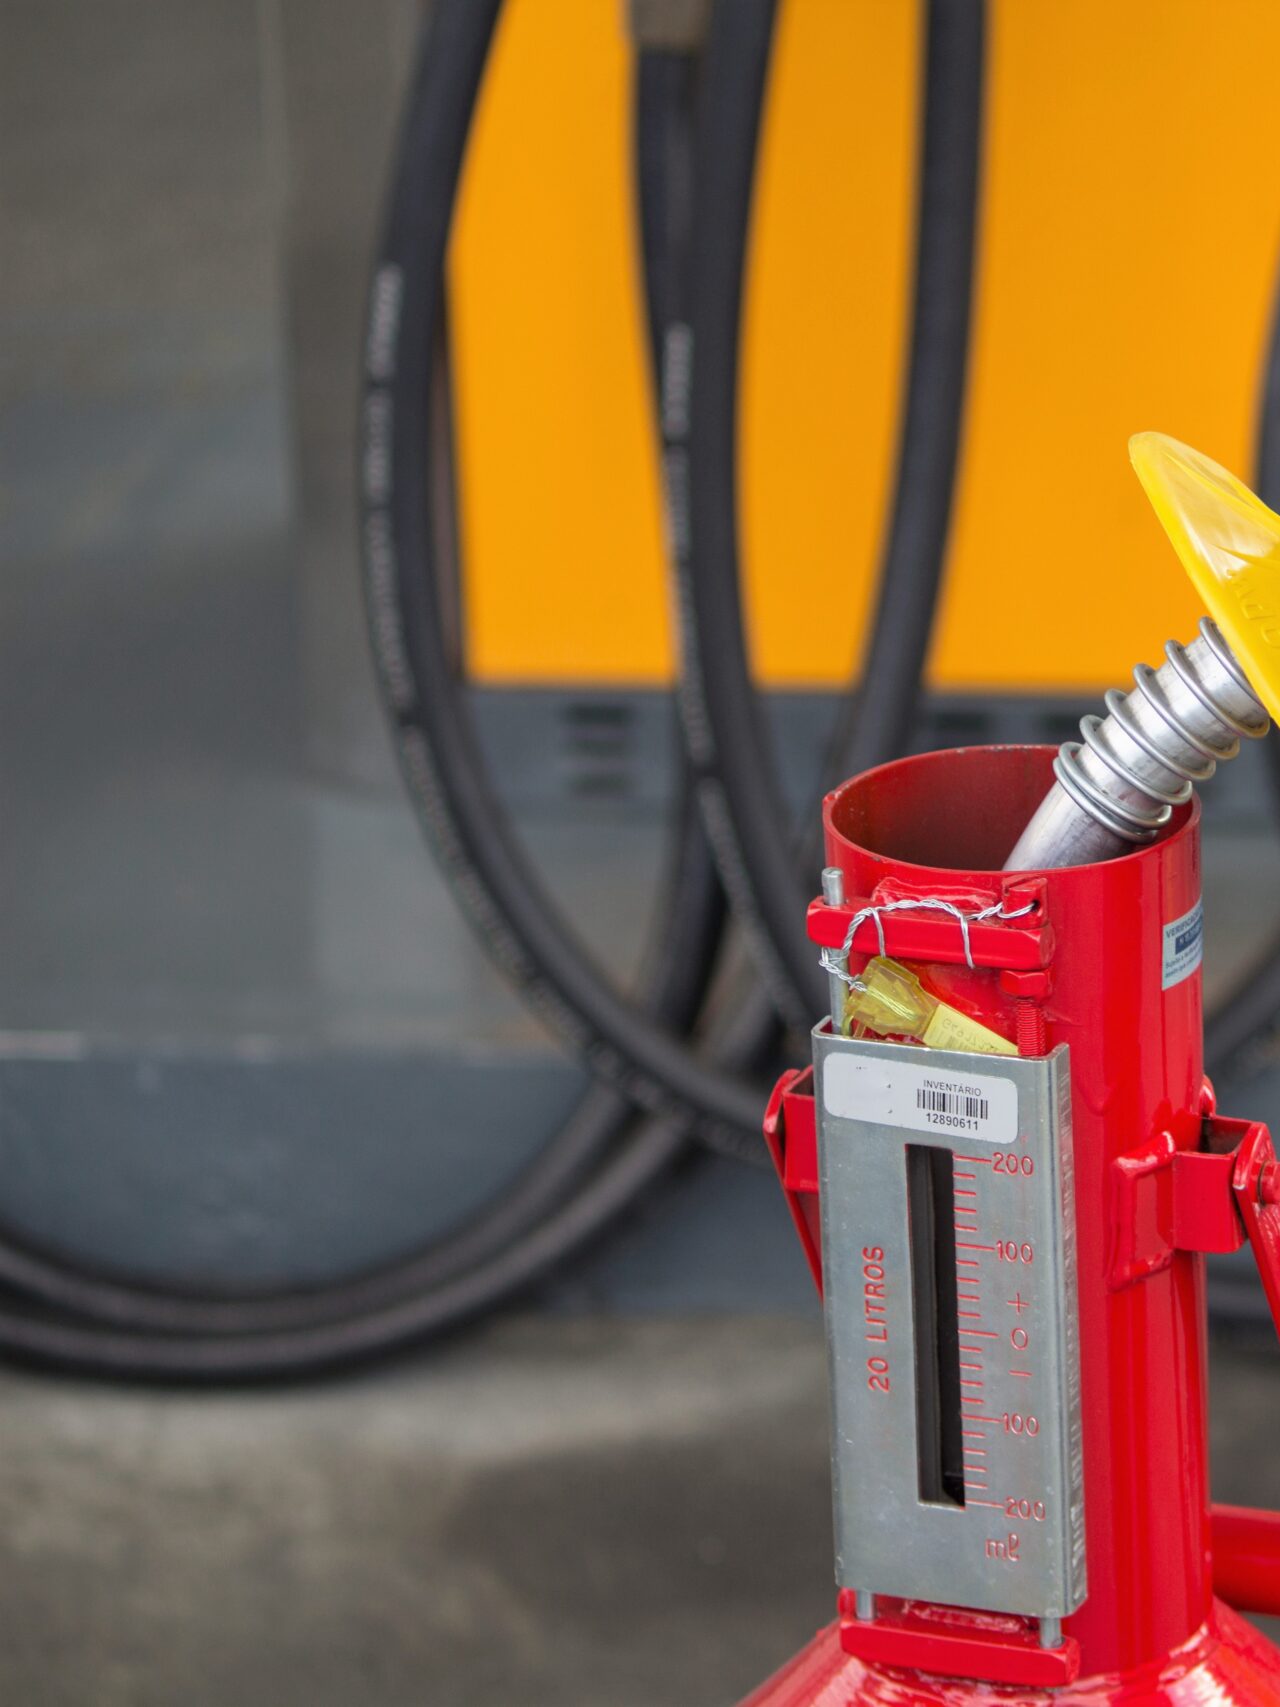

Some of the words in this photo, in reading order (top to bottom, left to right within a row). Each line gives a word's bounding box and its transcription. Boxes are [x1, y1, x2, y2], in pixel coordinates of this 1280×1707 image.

[923, 1079, 982, 1097] INVENTÁRIO
[926, 1113, 979, 1131] 12890611
[992, 1152, 1034, 1177] 200
[996, 1240, 1034, 1265] 100
[862, 1246, 888, 1342] LITROS
[866, 1356, 890, 1393] 20
[1002, 1413, 1040, 1437] 100
[1005, 1497, 1047, 1521] 200
